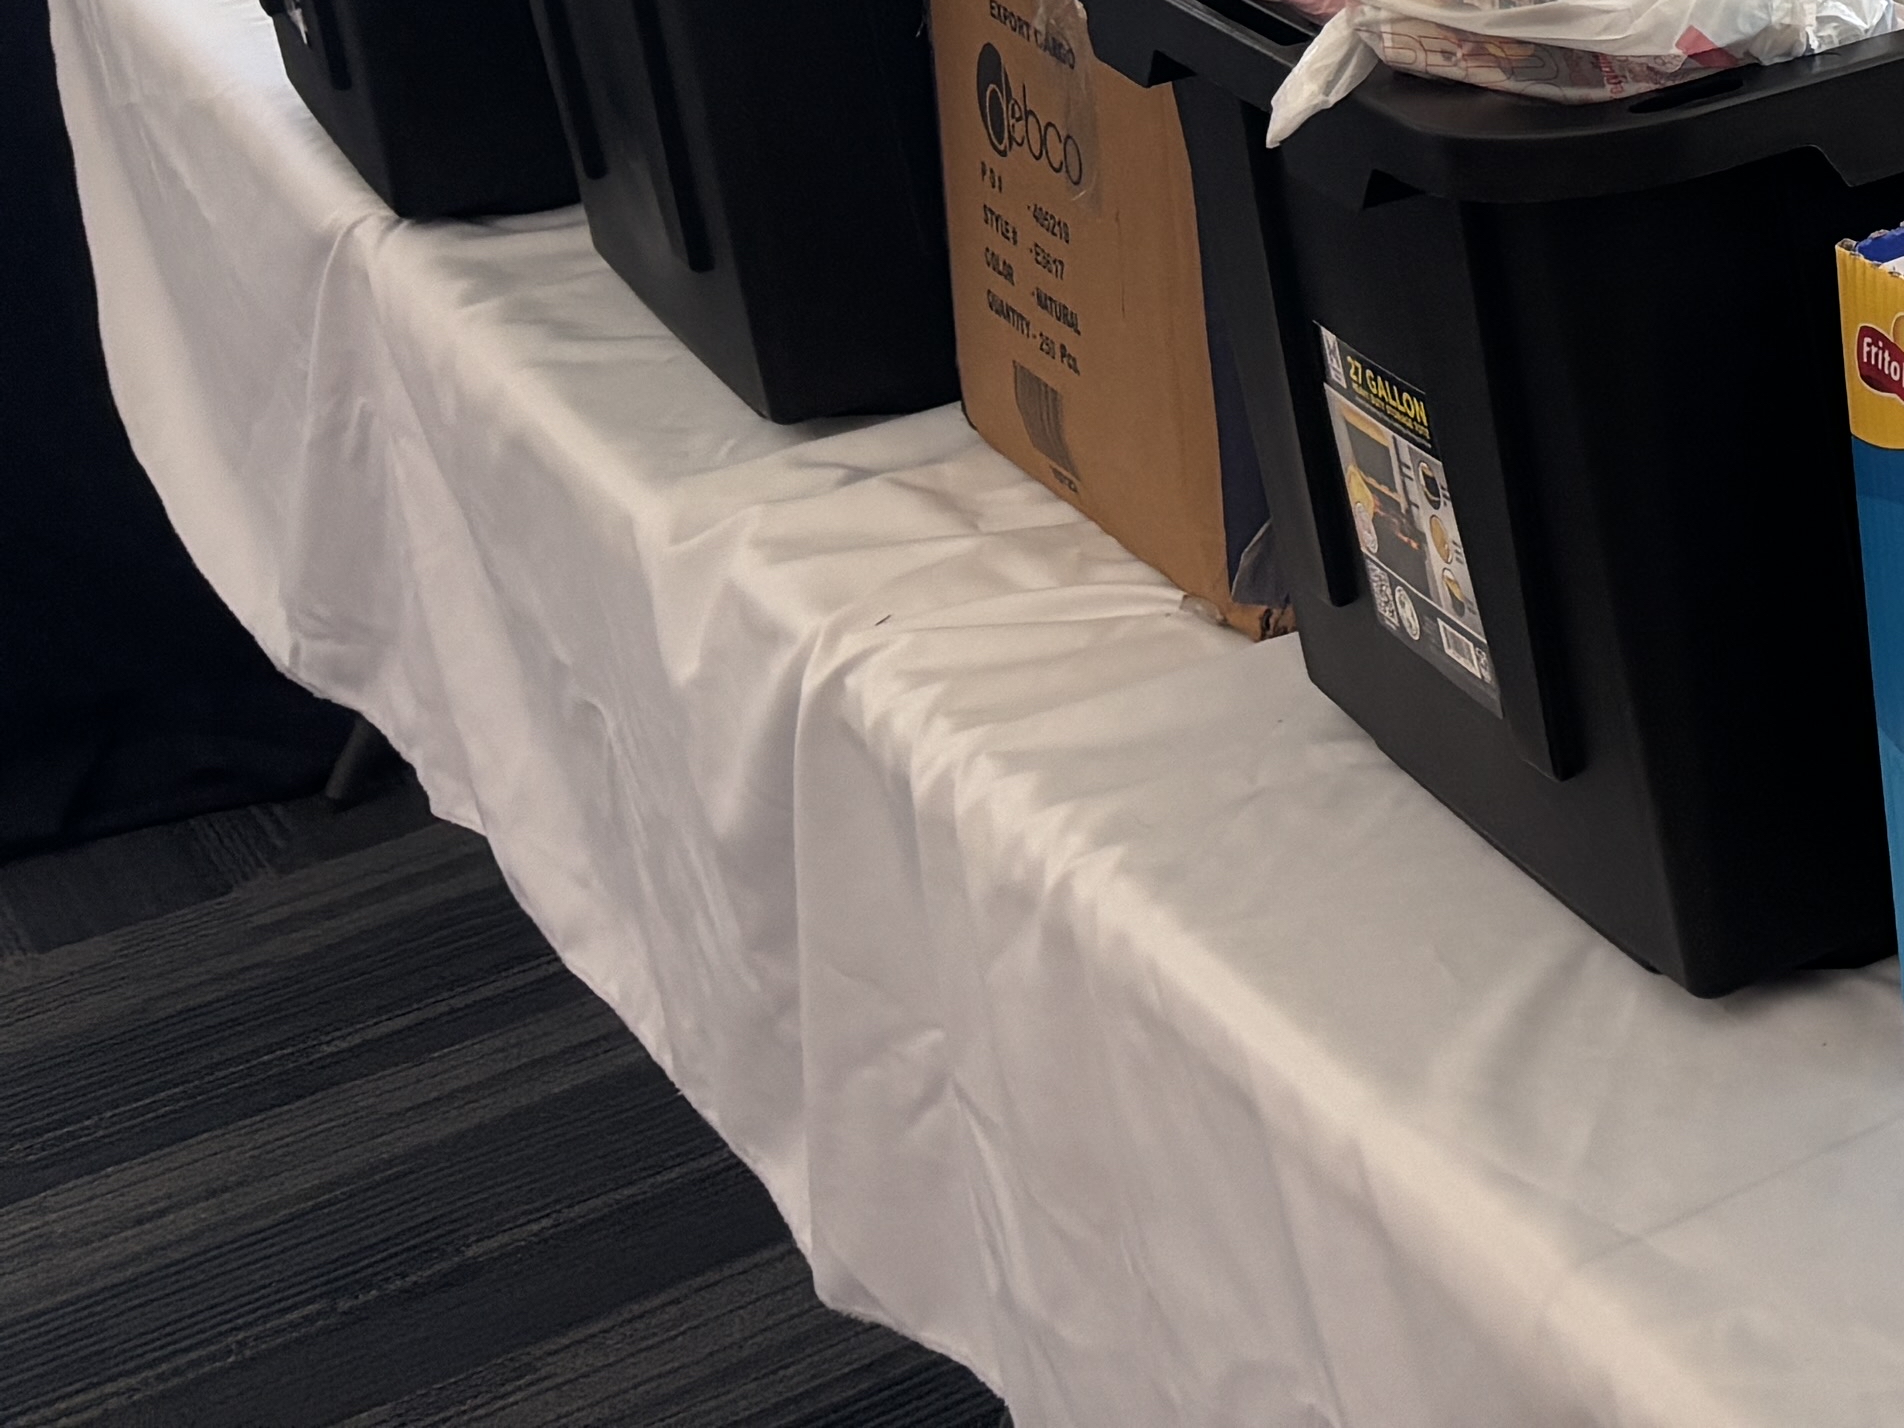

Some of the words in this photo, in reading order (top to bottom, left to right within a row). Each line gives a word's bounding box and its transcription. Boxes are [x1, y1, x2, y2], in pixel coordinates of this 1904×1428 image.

[977, 42, 1083, 186] debco
[986, 288, 1031, 339] QUANTITY
[1035, 286, 1082, 336] NATURAL
[1346, 355, 1362, 385] 27
[1365, 368, 1429, 427] GALLON
